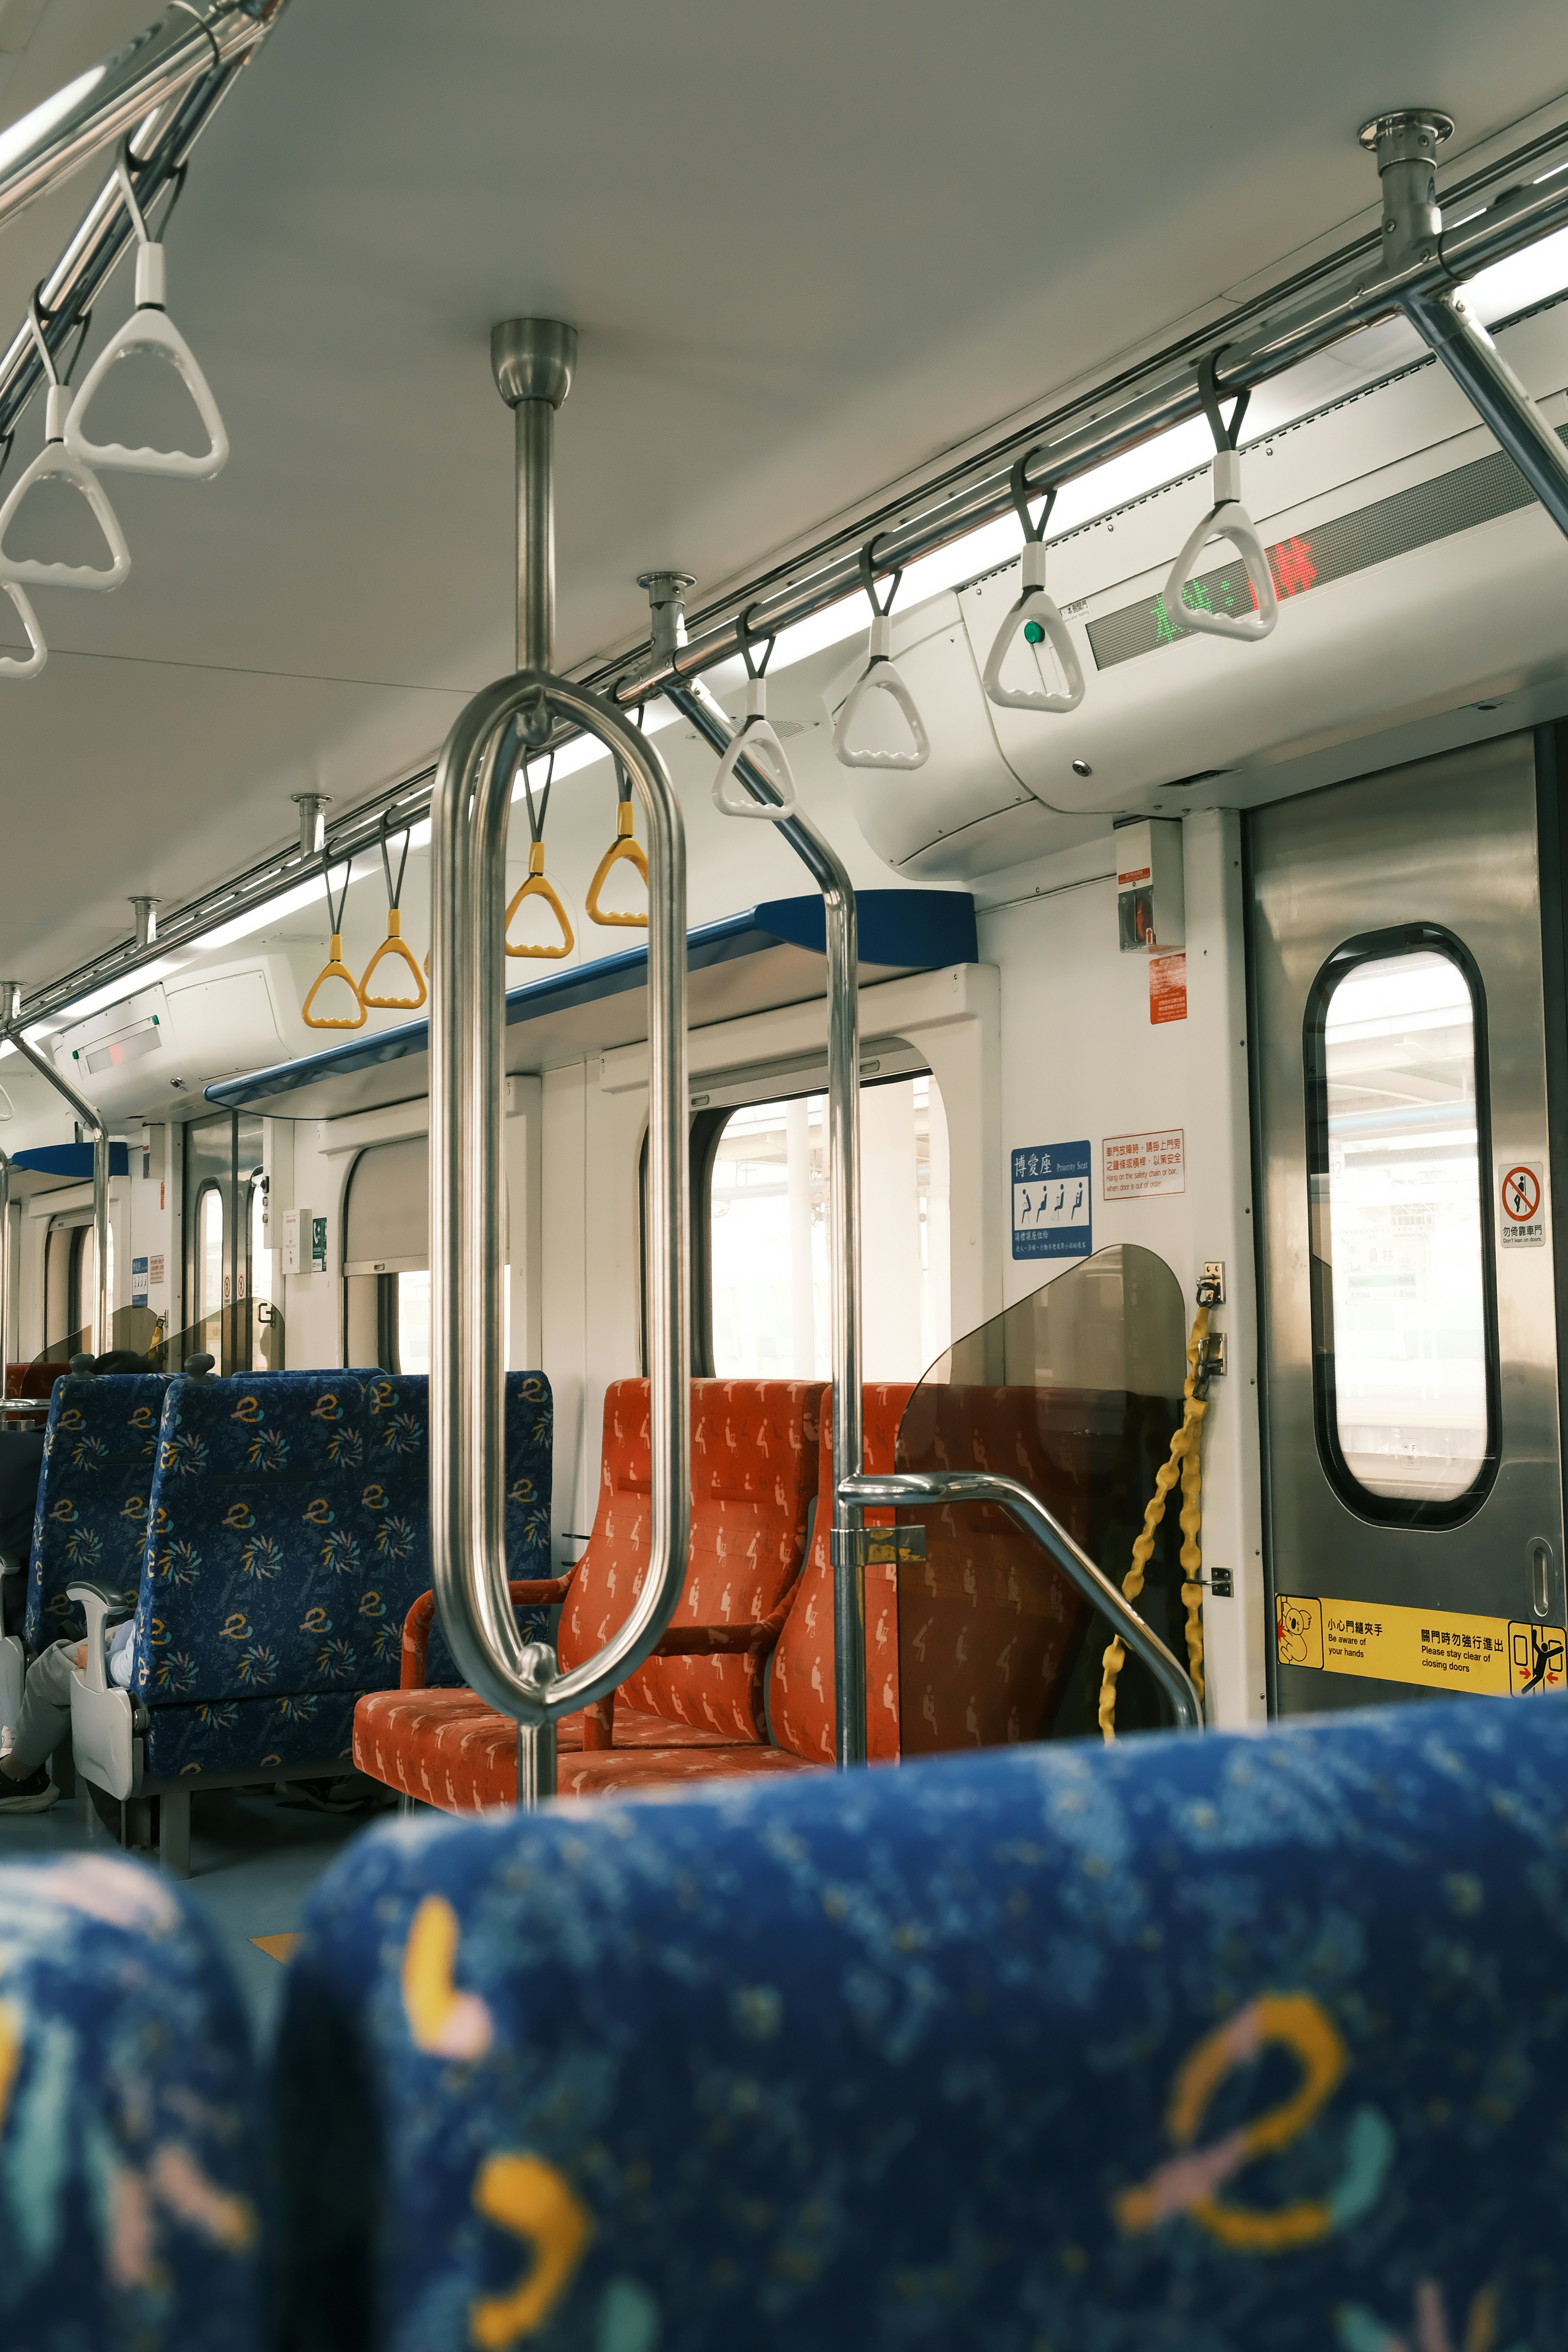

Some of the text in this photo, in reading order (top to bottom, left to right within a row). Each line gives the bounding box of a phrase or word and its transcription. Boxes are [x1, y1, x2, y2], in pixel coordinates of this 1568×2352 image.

[1014, 1153, 1052, 1178] 博愛座
[1057, 1162, 1075, 1172] Priority
[1503, 1225, 1542, 1237] 勿倚靠車門
[1328, 1618, 1383, 1636] 小心門縫夾手
[1329, 1634, 1337, 1642] Be
[1421, 1629, 1504, 1652] 關門時勿強行進出
[1344, 1648, 1364, 1657] hands
[1422, 1645, 1491, 1662] Please stay clear of
[1422, 1658, 1470, 1672] closing doors
